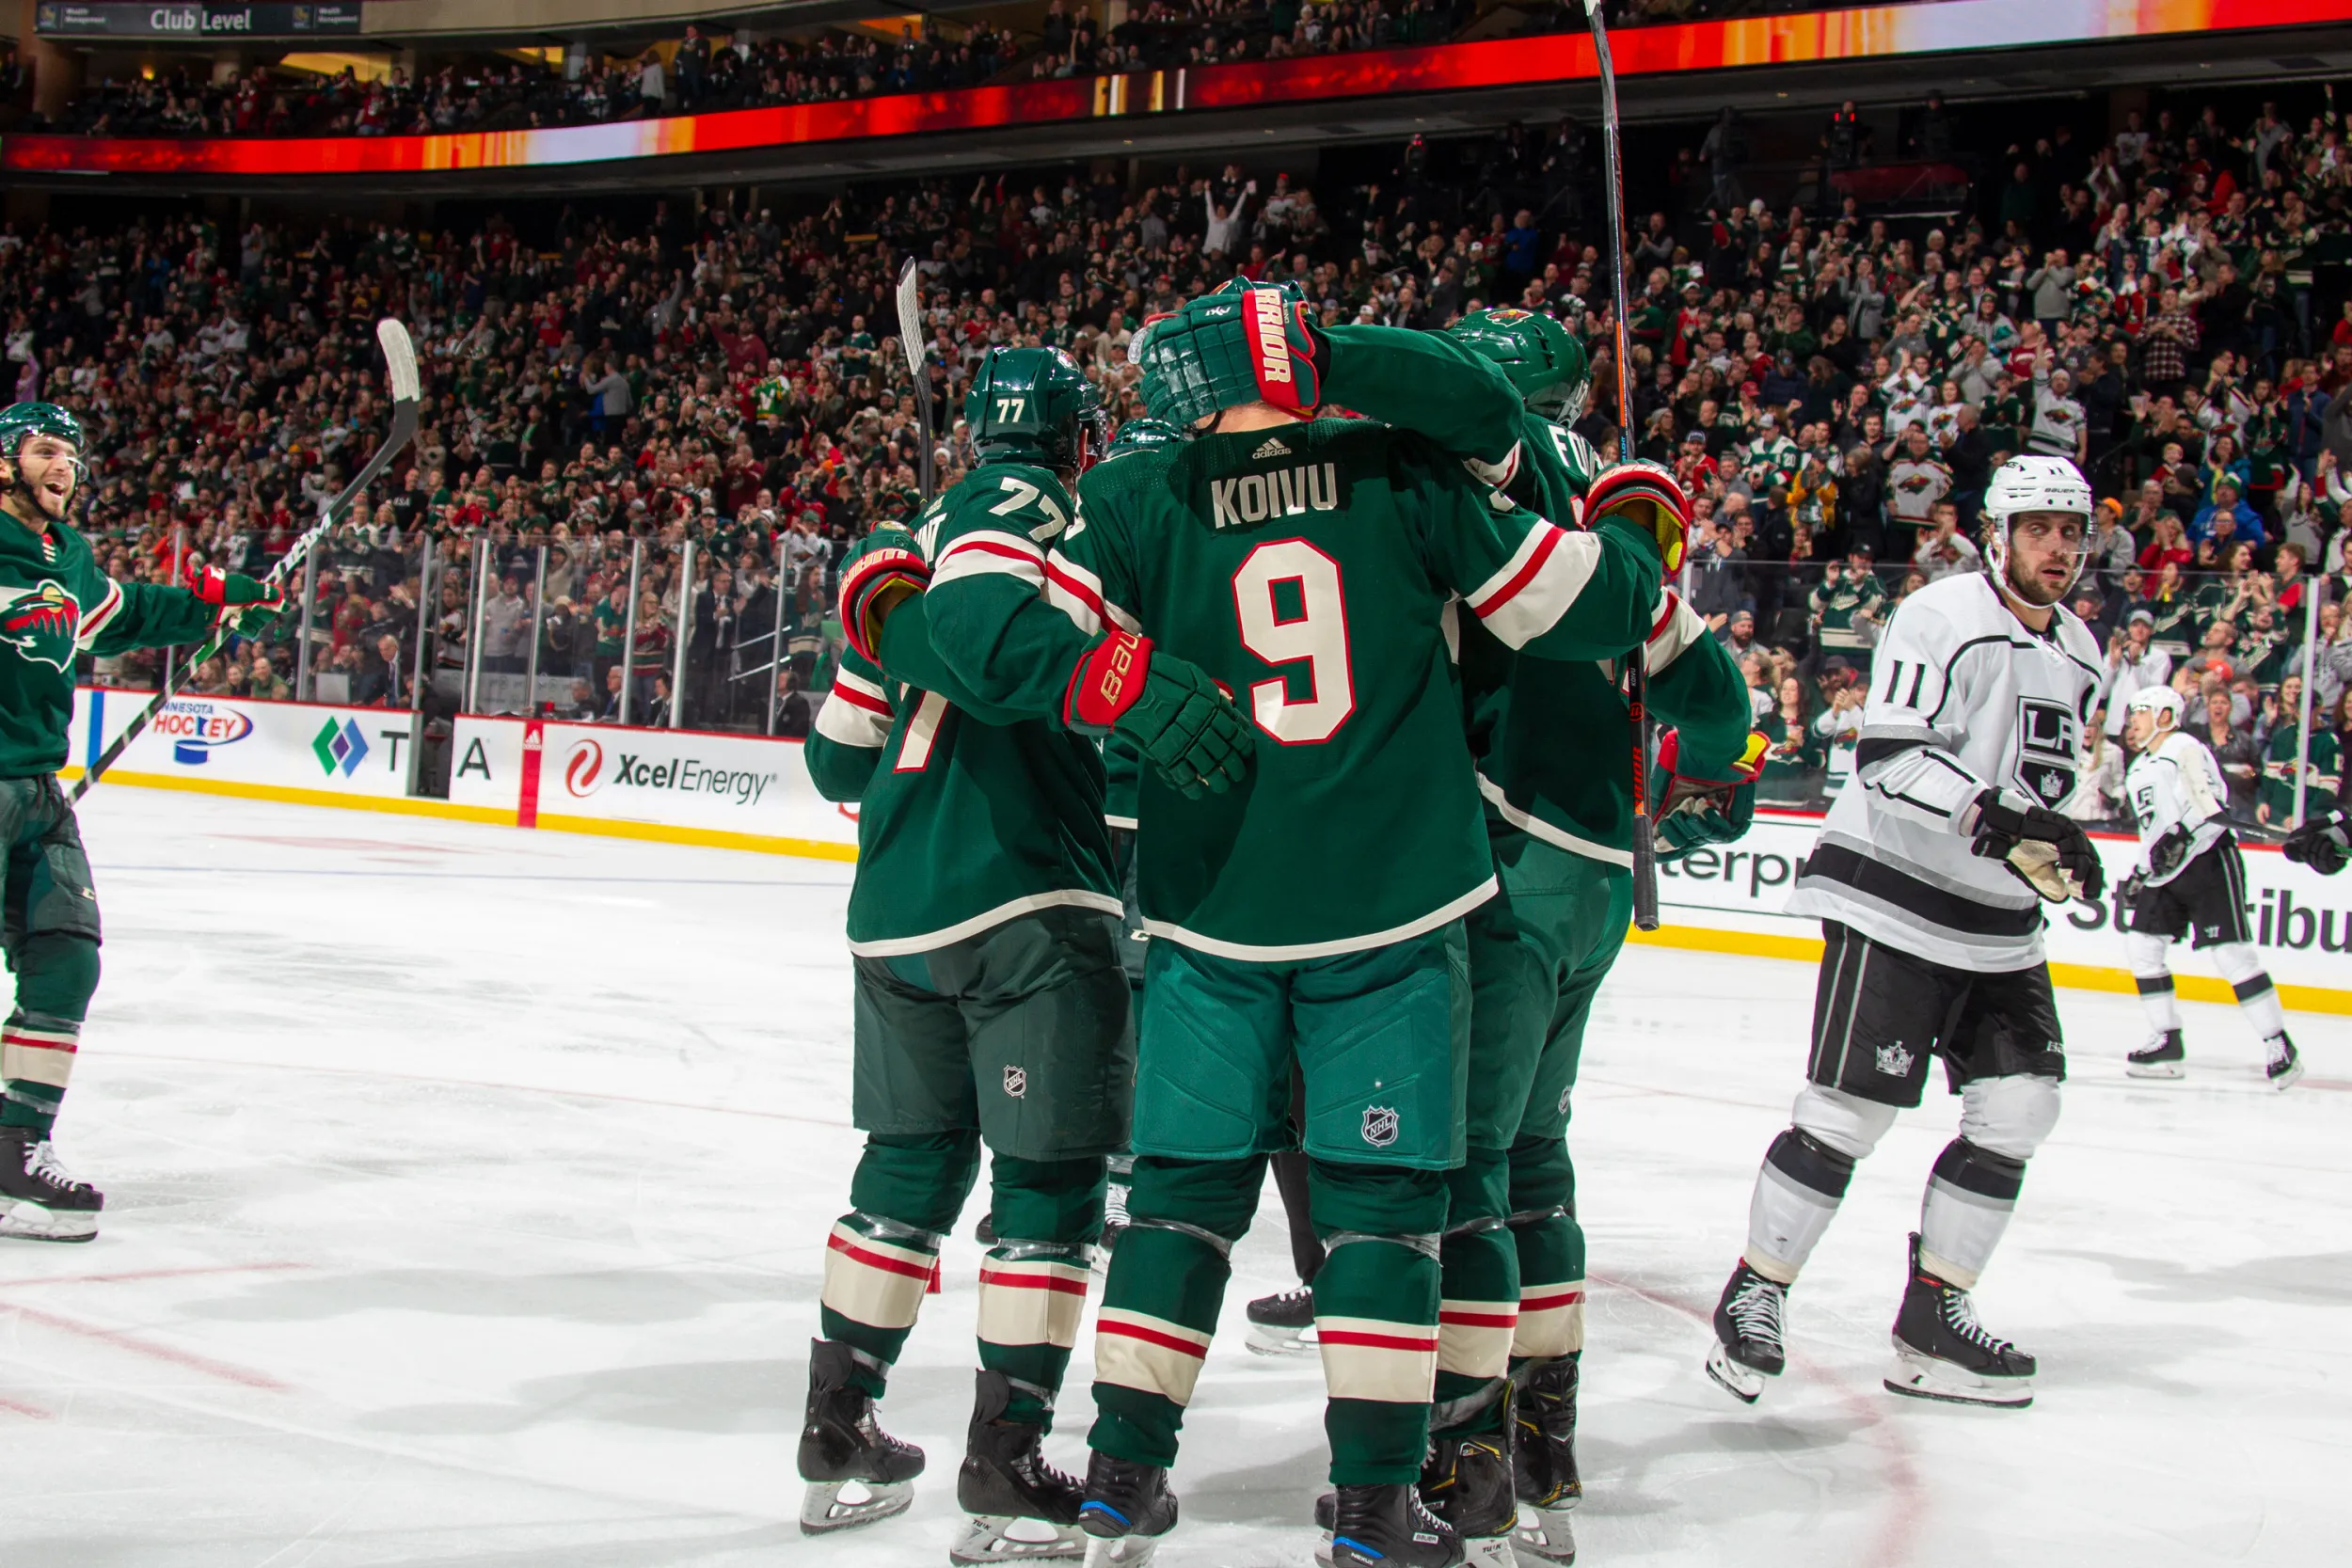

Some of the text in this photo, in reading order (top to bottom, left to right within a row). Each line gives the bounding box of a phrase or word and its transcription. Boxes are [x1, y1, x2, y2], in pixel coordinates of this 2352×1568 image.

[150, 8, 252, 31] Club Level
[995, 398, 1025, 425] 77
[1251, 447, 1293, 460] adidas
[988, 476, 1068, 543] 77
[1210, 462, 1338, 530] KOIVU
[1231, 536, 1357, 747] 9
[1883, 659, 1926, 709] 11
[161, 702, 215, 716] NNESOTA
[380, 730, 492, 781] T A
[612, 753, 679, 790] Xcel
[1370, 1117, 1391, 1137] NHL
